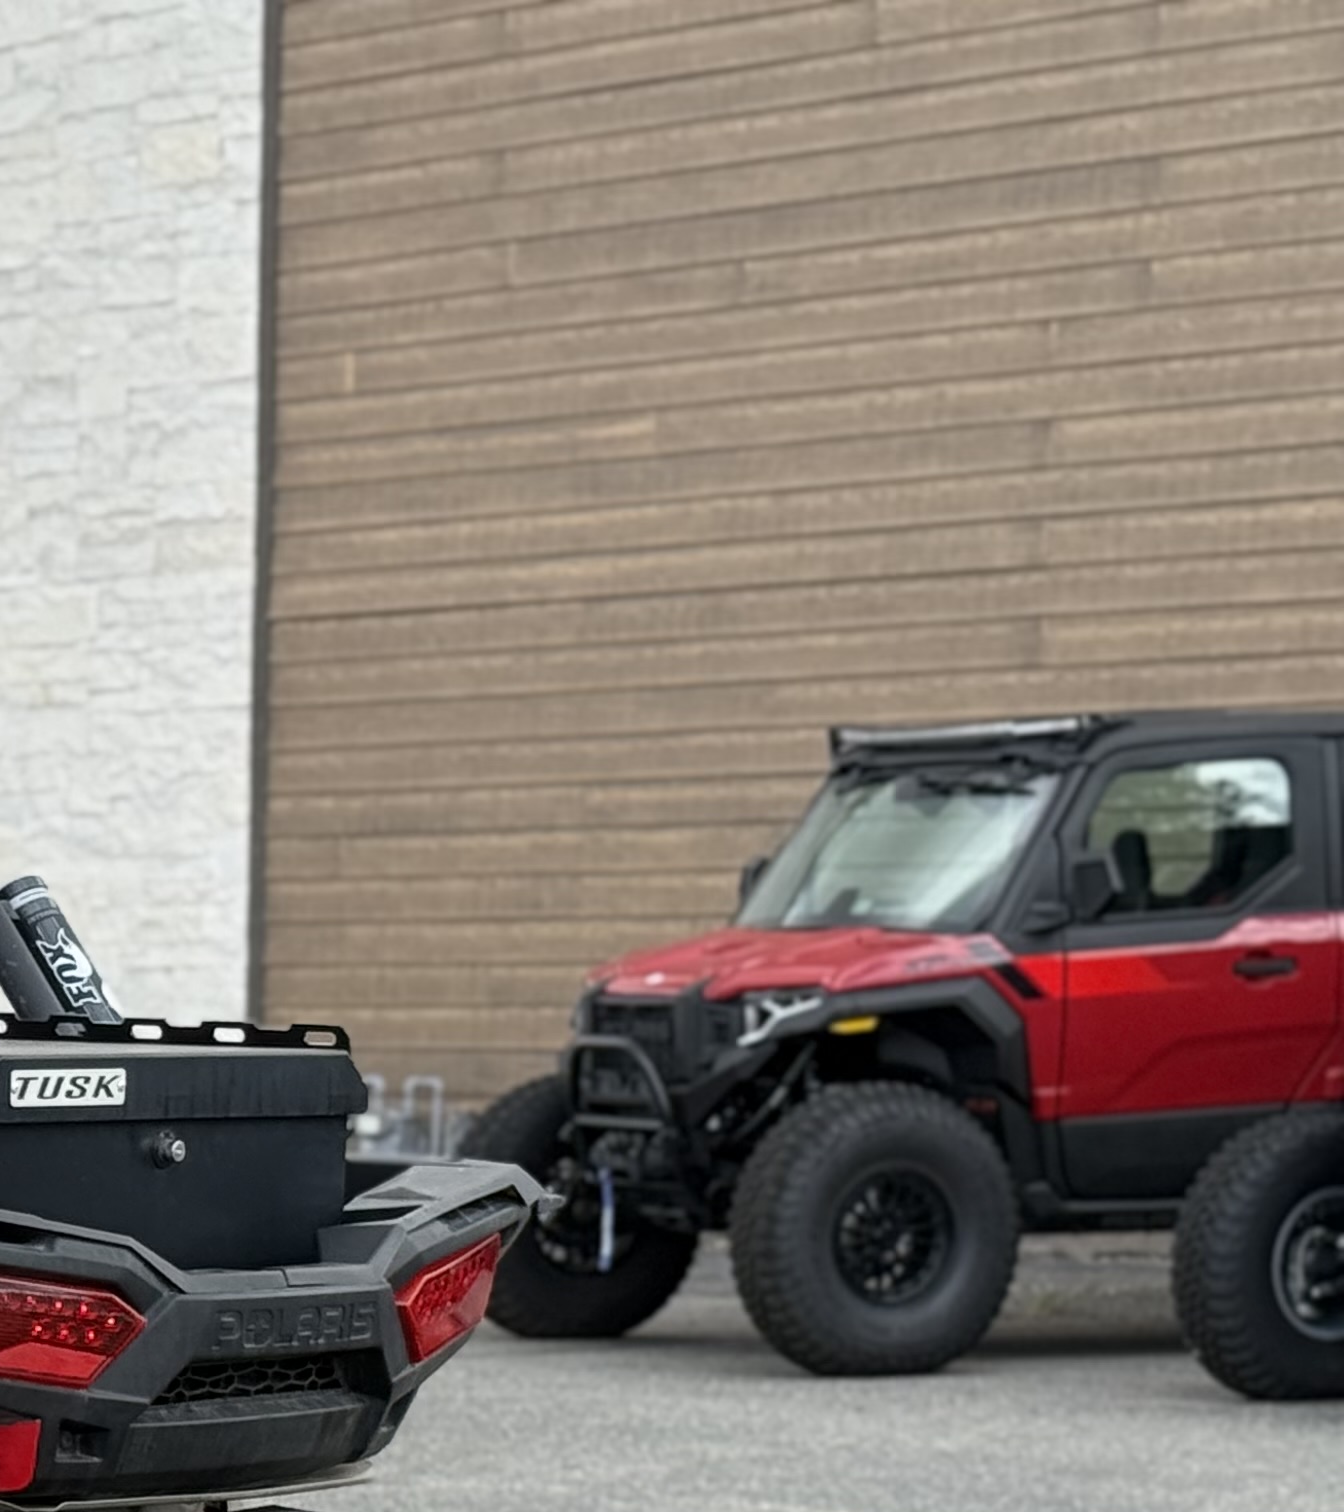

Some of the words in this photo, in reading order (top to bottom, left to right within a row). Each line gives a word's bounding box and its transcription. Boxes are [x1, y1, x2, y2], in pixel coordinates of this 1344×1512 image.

[36, 928, 100, 1007] FOX
[14, 1075, 121, 1100] TUSK
[212, 1303, 376, 1350] POLARIS
